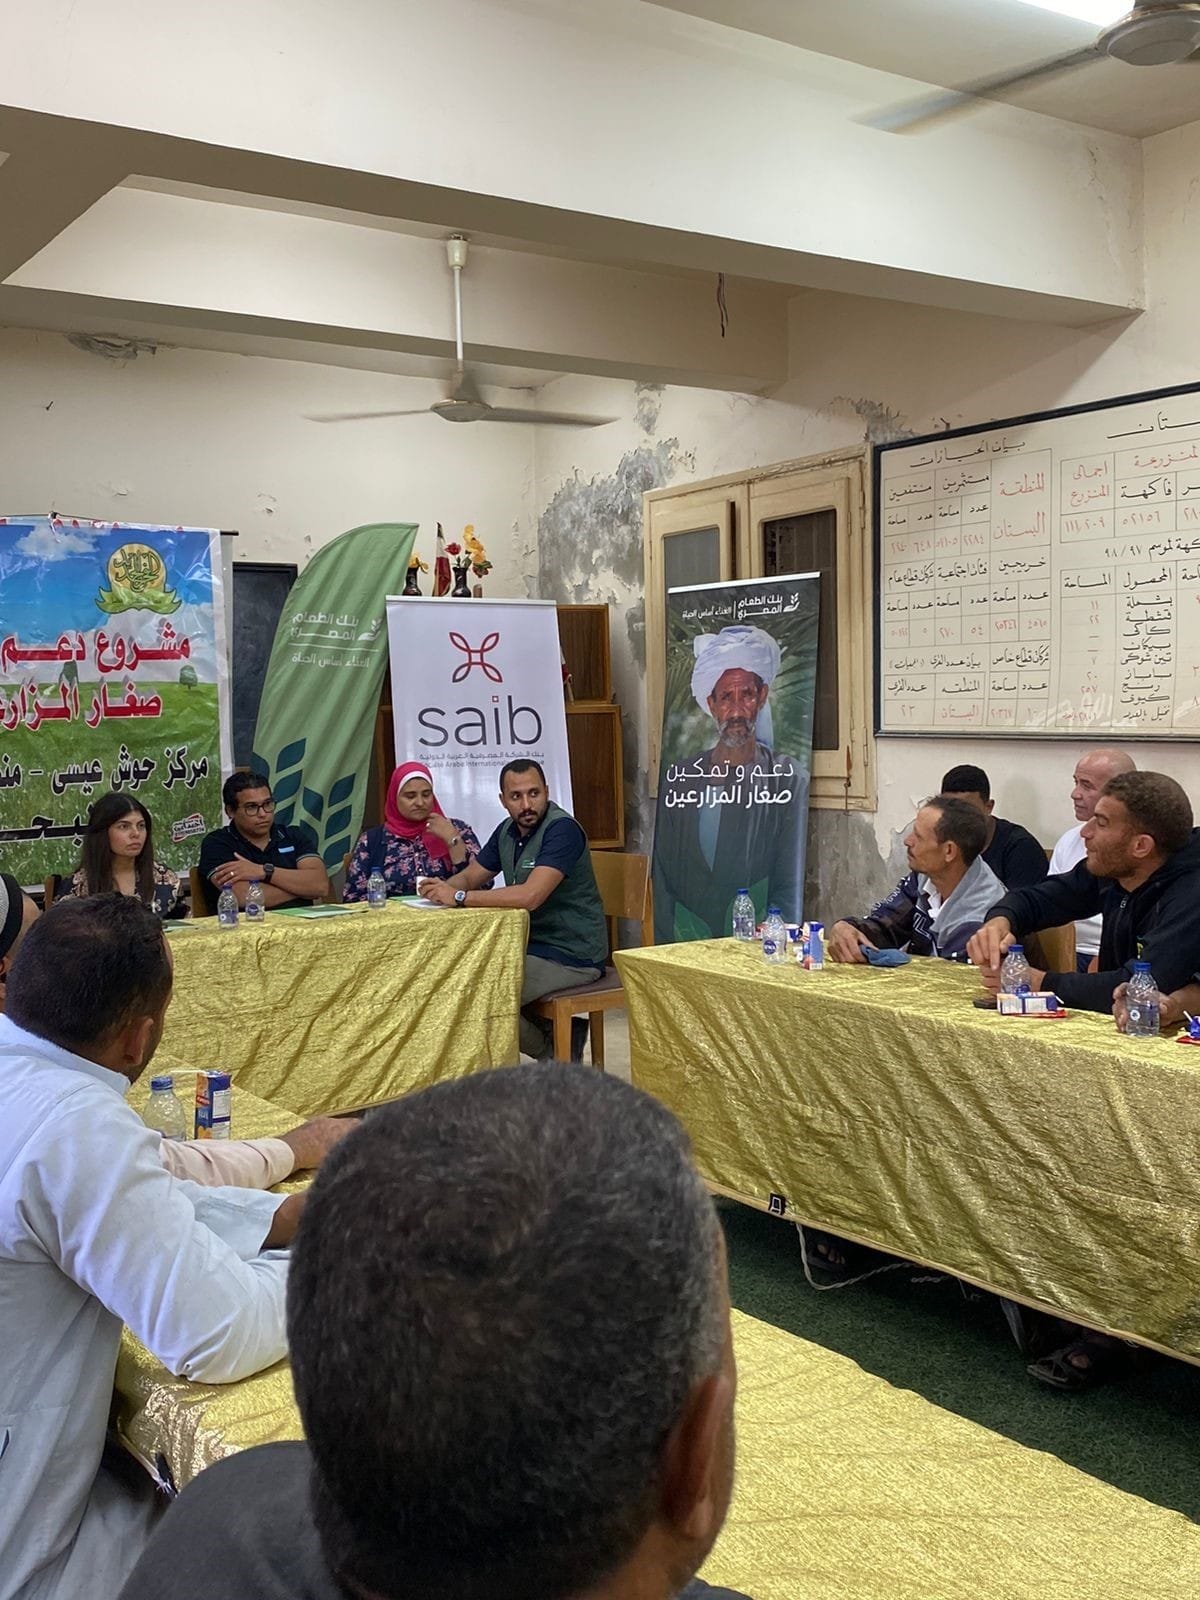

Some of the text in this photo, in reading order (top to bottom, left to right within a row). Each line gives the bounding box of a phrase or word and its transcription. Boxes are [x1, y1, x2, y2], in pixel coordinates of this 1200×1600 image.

[991, 437, 1025, 453] بيان
[1000, 472, 1045, 497] المنطقة
[1120, 477, 1172, 499] فاكهة
[888, 504, 989, 525] عدد مساحة عدد مساحة
[993, 512, 1045, 540] البستان
[998, 556, 1047, 575] خريجين
[1064, 573, 1111, 588] المساحة
[1123, 567, 1171, 590] المحصول
[738, 594, 782, 608] بنك الطعام
[887, 592, 988, 611] عدد مساحة عدد مساحة
[993, 587, 1049, 601] عدد مساحة
[292, 612, 359, 626] بنك الطعام
[1, 621, 190, 673] مشروع دعم
[992, 677, 1048, 691] عدد مساحة
[85, 682, 162, 728] صغار
[418, 695, 542, 746] saib
[51, 758, 103, 795] عيسى
[110, 745, 156, 791] حوش
[162, 746, 208, 790] مركز
[666, 758, 794, 783] دعم و تمكين
[665, 785, 792, 809] صغار المزارعين
